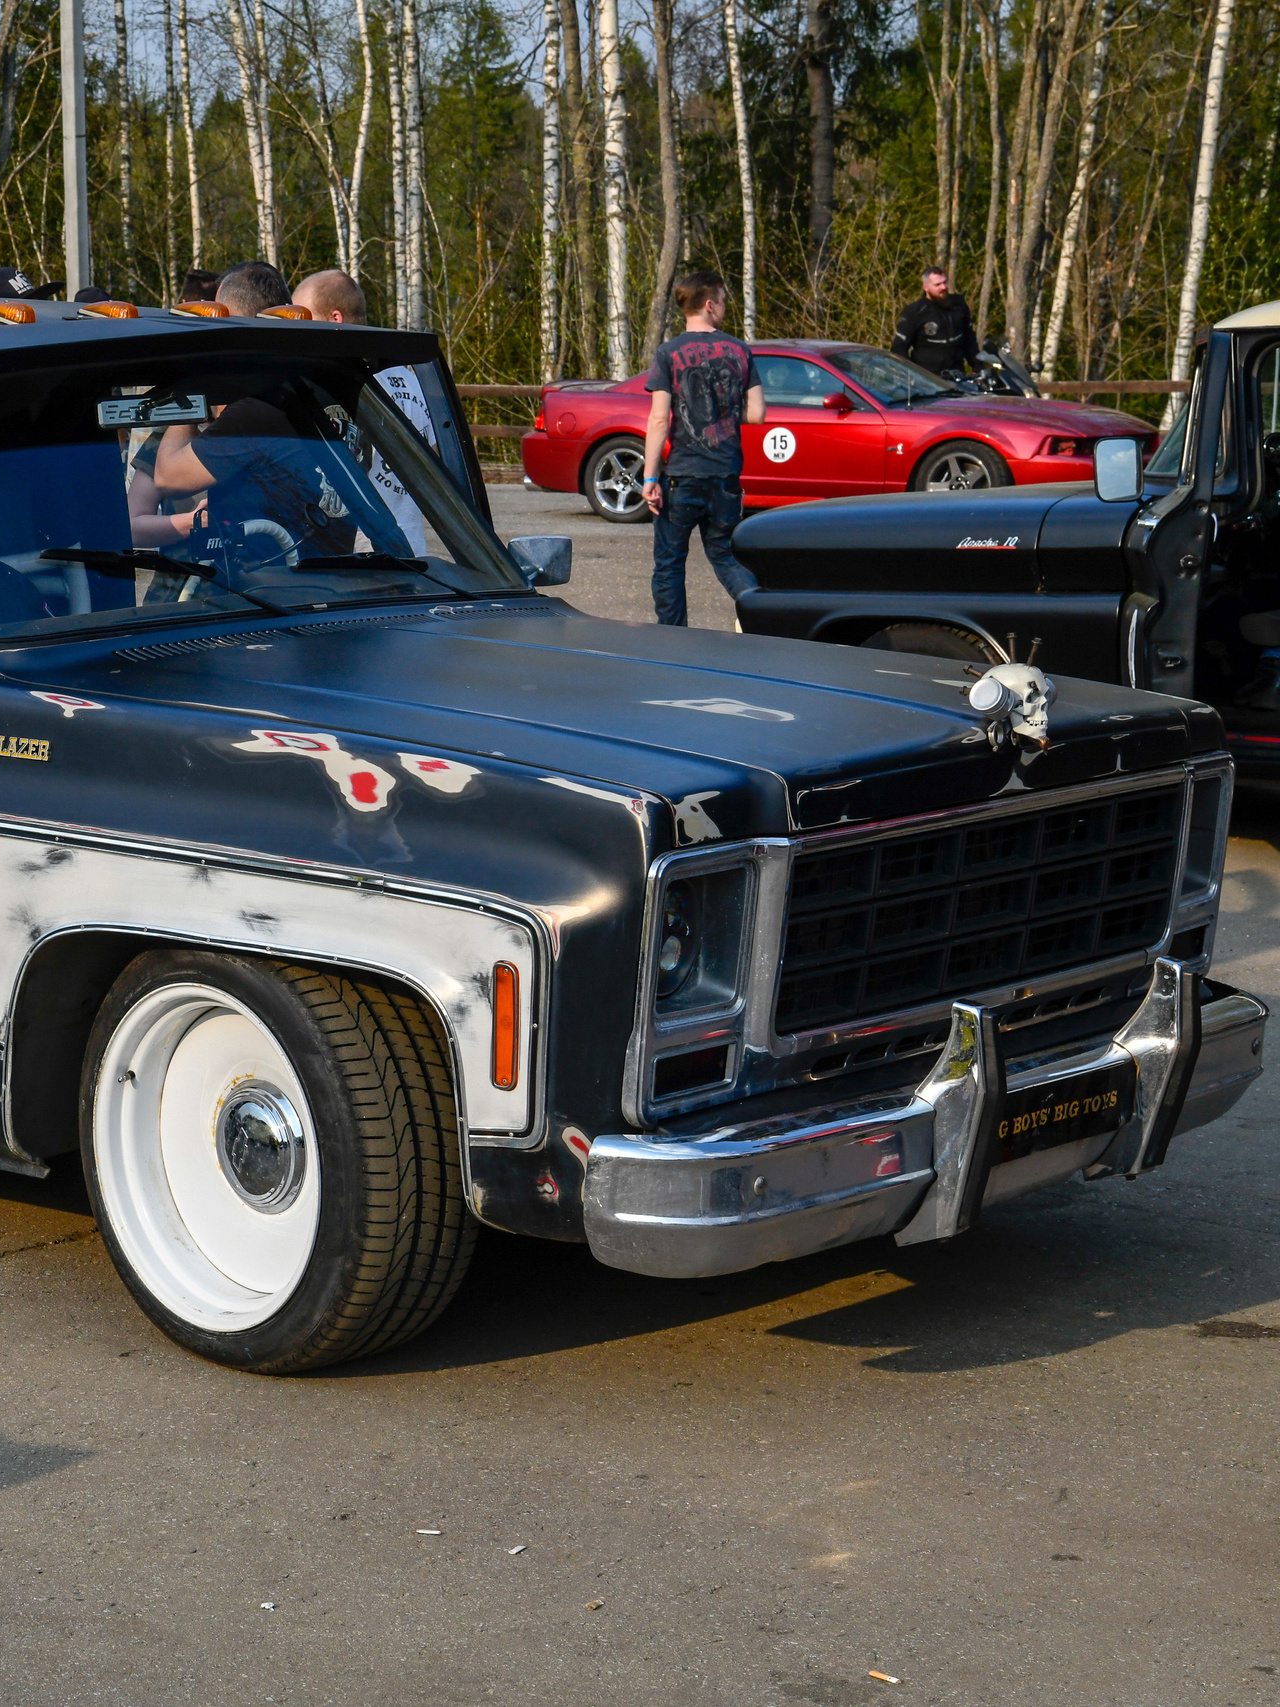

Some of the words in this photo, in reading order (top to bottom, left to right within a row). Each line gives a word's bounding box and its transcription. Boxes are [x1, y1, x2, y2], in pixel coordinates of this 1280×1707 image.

[770, 435, 788, 450] 15
[957, 536, 999, 548] Apache
[1003, 536, 1019, 547] 10
[1053, 1100, 1080, 1122] BIG
[1082, 1090, 1118, 1114] TOYS
